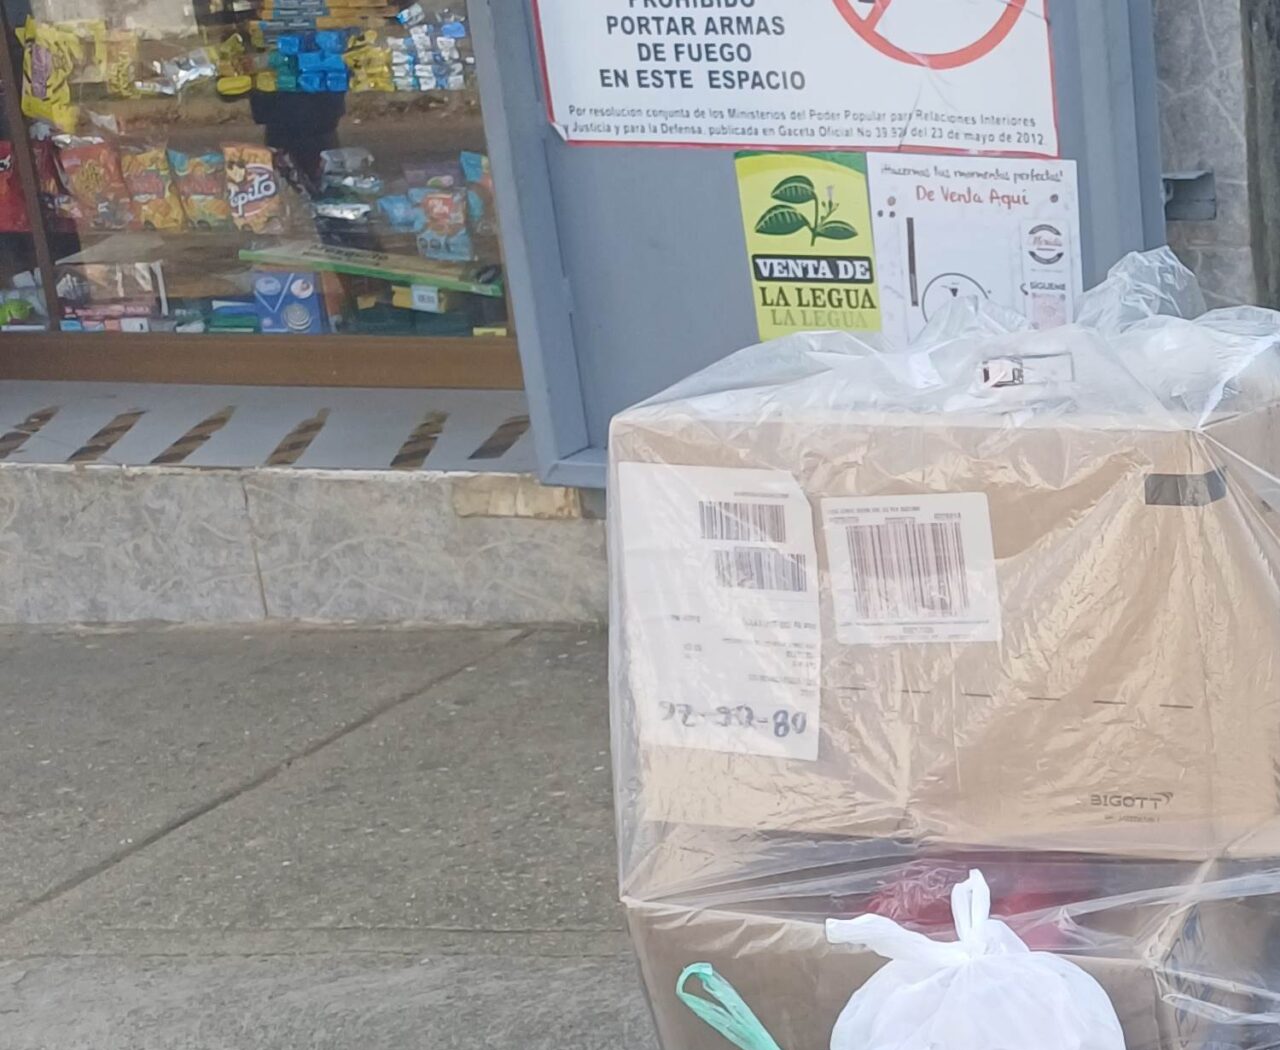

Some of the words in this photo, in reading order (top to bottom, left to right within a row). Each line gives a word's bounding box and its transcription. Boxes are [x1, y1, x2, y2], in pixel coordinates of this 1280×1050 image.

[606, 15, 697, 35] PORTAR
[704, 16, 786, 36] ARMAS
[636, 42, 667, 62] DE
[673, 43, 752, 63] FUEGO
[599, 68, 629, 88] EN
[636, 69, 694, 89] ESTE
[707, 70, 806, 91] ESPACIO
[568, 104, 586, 117] Por
[646, 107, 690, 121] conjunta
[694, 108, 706, 119] de
[709, 108, 725, 119] los
[727, 108, 786, 120] Ministerios
[790, 110, 806, 121] del
[809, 109, 841, 121] Poder
[844, 109, 886, 123] Popular
[916, 109, 977, 126] Relaciones
[980, 113, 1036, 127] Interiores
[573, 121, 612, 134] Justicia
[614, 124, 621, 136] y
[624, 123, 646, 135] para
[649, 123, 658, 134] la
[709, 124, 759, 137] publicada
[762, 126, 776, 137] en
[778, 125, 816, 138] Gaceta
[819, 126, 854, 138] Oficial
[911, 127, 928, 138] del
[947, 129, 960, 141] de
[963, 131, 995, 144] mayo
[999, 131, 1013, 143] de
[917, 185, 935, 202] De
[941, 186, 983, 204] Venta
[755, 258, 835, 279] VENTA
[836, 260, 871, 280] DE
[759, 285, 791, 307] LA
[795, 286, 877, 309] LEGUA
[771, 308, 798, 326] LA
[799, 309, 868, 328] LEGUA
[1090, 793, 1162, 811] BIGOTT
